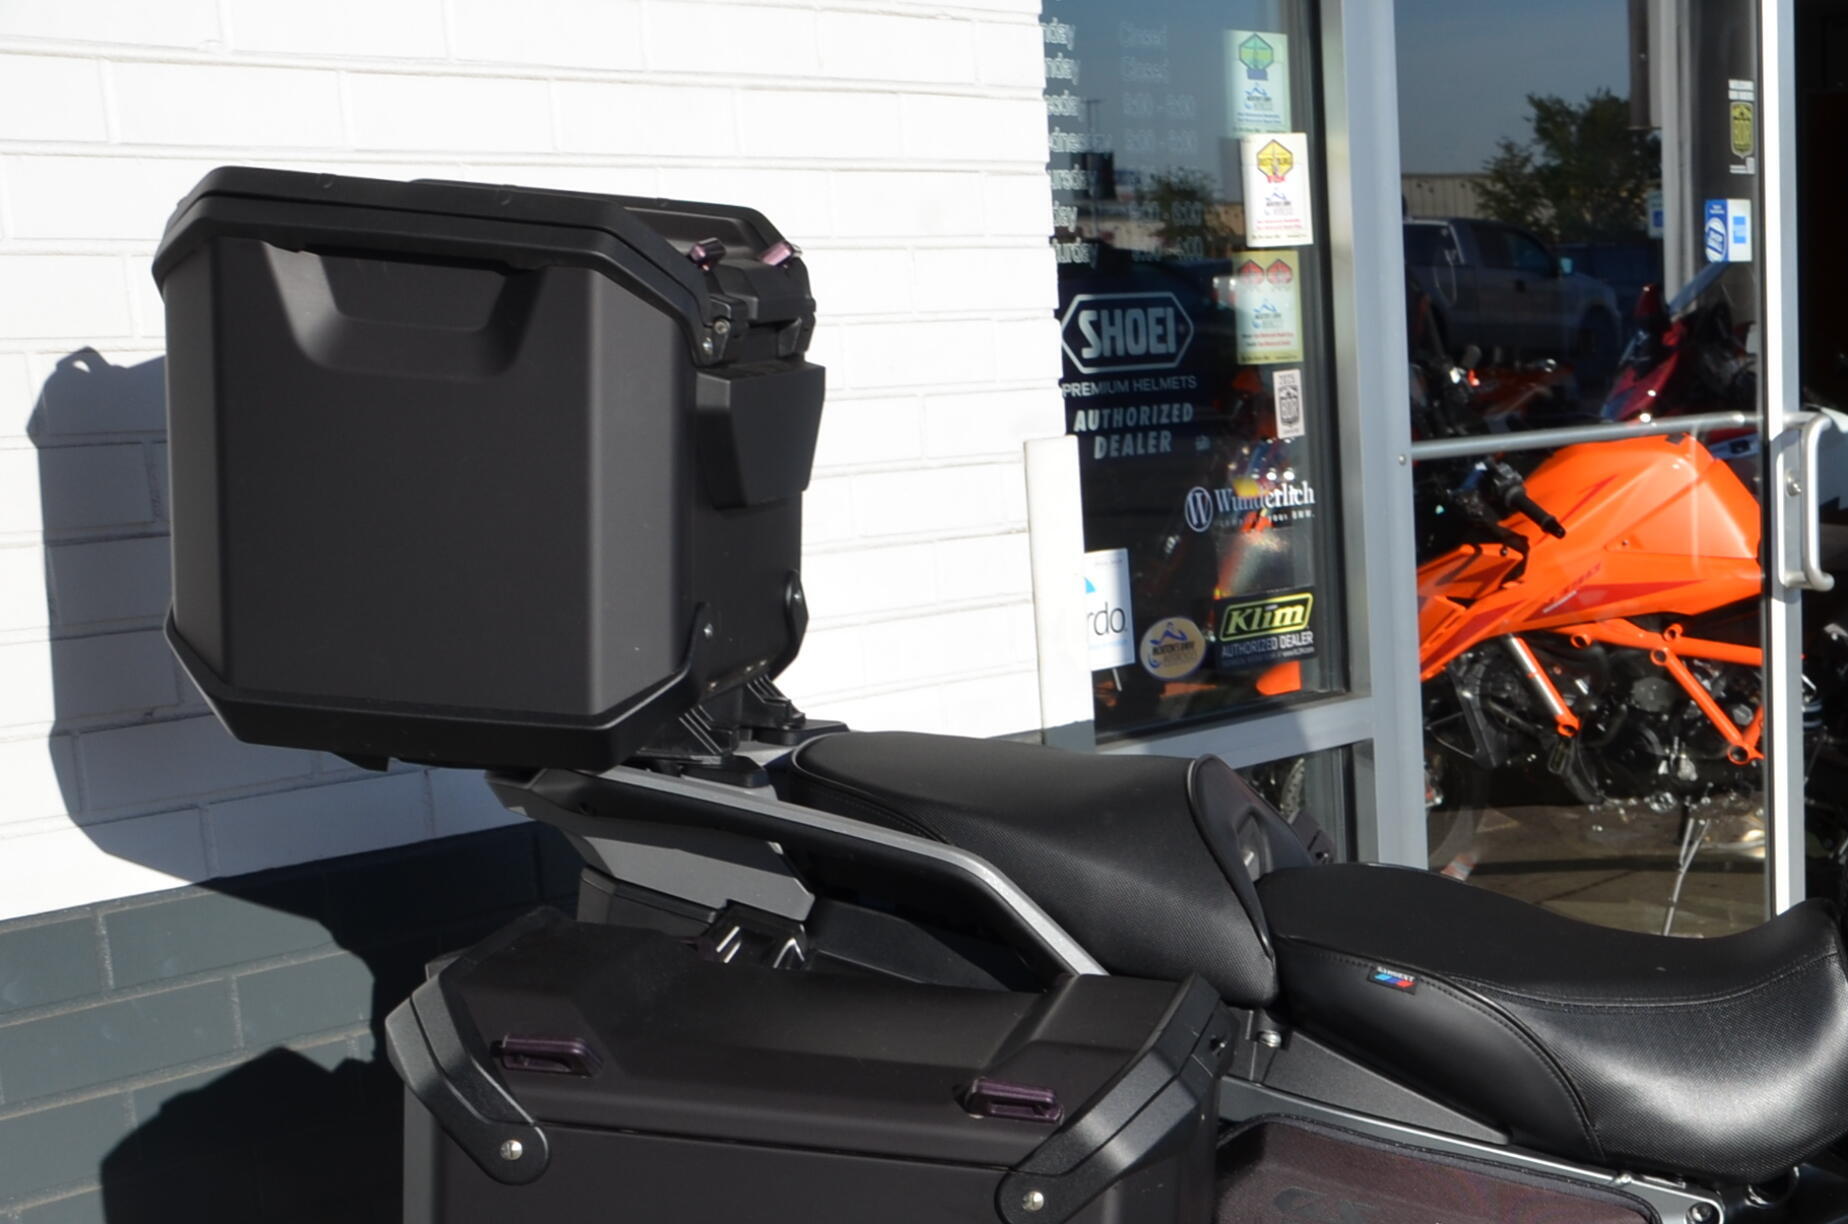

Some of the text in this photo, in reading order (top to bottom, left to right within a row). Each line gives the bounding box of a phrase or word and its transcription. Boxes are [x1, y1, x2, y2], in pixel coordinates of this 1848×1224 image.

[1078, 307, 1177, 360] SHOEI
[1062, 374, 1199, 398] PREMIUM HELMETS
[1073, 402, 1194, 433] AUTHORIZED
[1094, 430, 1173, 460] DEALER
[1087, 601, 1125, 636] rdo
[1221, 637, 1279, 658] AUTHORIZED
[1279, 631, 1314, 649] DEALER
